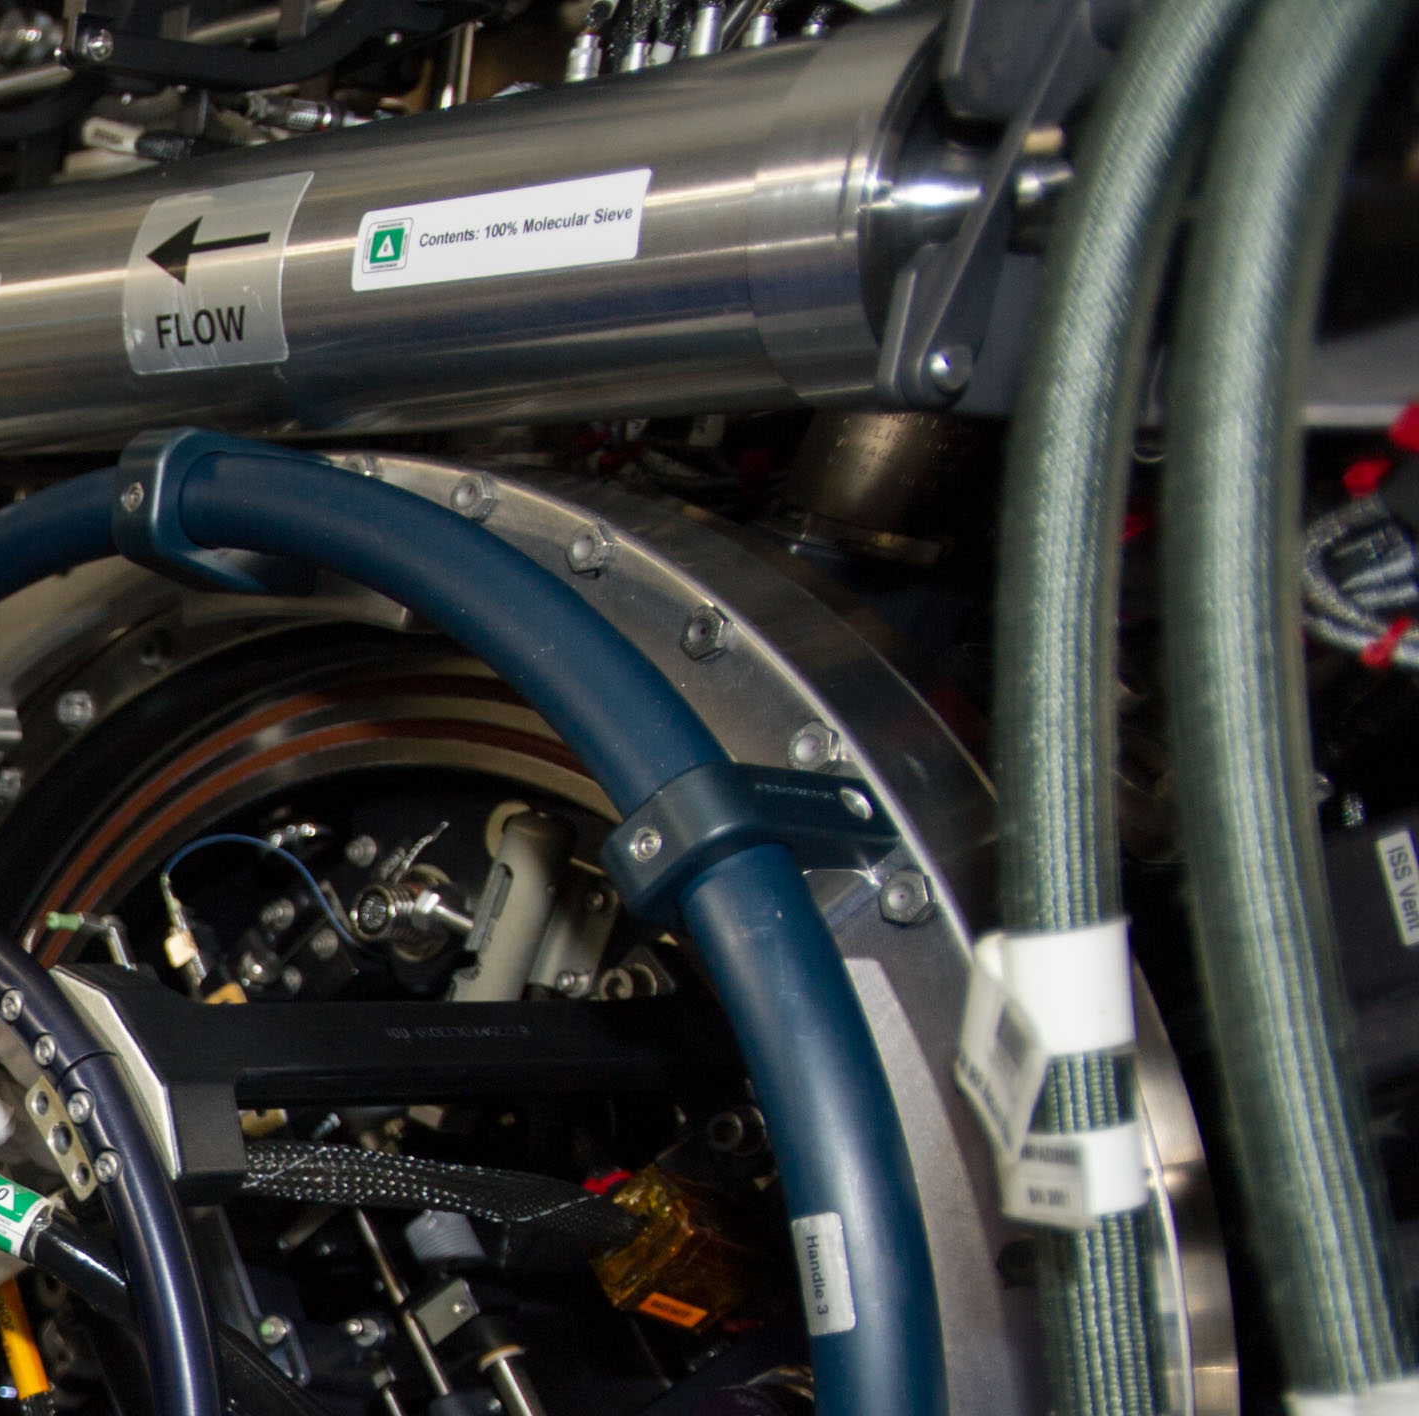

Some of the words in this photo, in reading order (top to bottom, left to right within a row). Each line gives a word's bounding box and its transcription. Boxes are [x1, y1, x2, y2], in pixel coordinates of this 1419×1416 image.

[419, 229, 480, 248] Contents:
[484, 221, 518, 239] 100%
[523, 213, 590, 234] Molecular
[593, 205, 633, 224] Sieve
[155, 305, 246, 350] FLOW
[1387, 845, 1412, 882] ISS
[805, 1235, 826, 1299] Handle
[817, 1304, 830, 1316] 3
